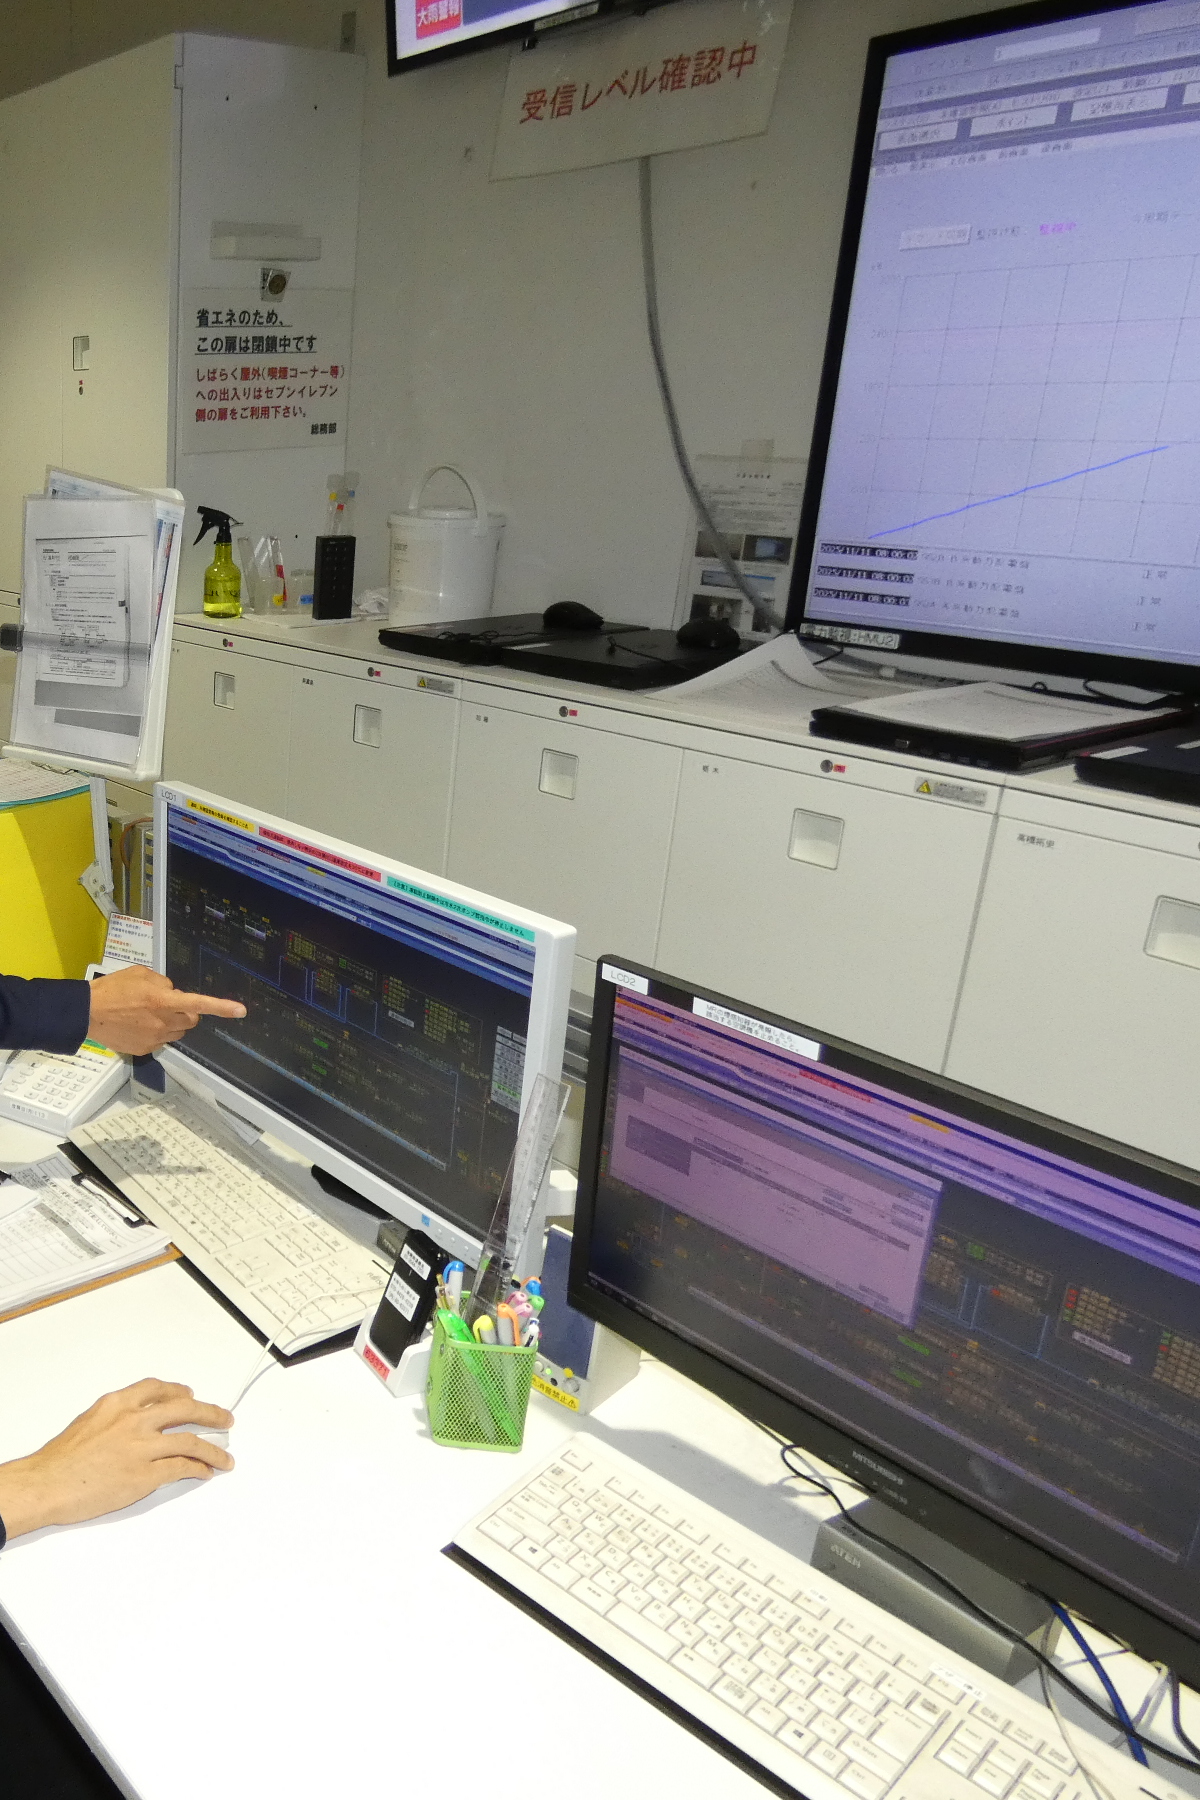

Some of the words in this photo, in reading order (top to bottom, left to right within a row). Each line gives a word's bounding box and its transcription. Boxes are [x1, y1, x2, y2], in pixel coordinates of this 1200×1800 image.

[519, 40, 757, 124] 受信レベル確認中
[197, 309, 285, 327] 省エネのため、
[197, 335, 317, 352] この扉は閉鎖中です
[196, 385, 338, 401] への出入りはセブンイレブン
[195, 406, 307, 422] 側の扉をご利用下さい。
[162, 789, 177, 801] LCD1
[610, 970, 636, 987] LCD2
[831, 1544, 861, 1568] ATEN
